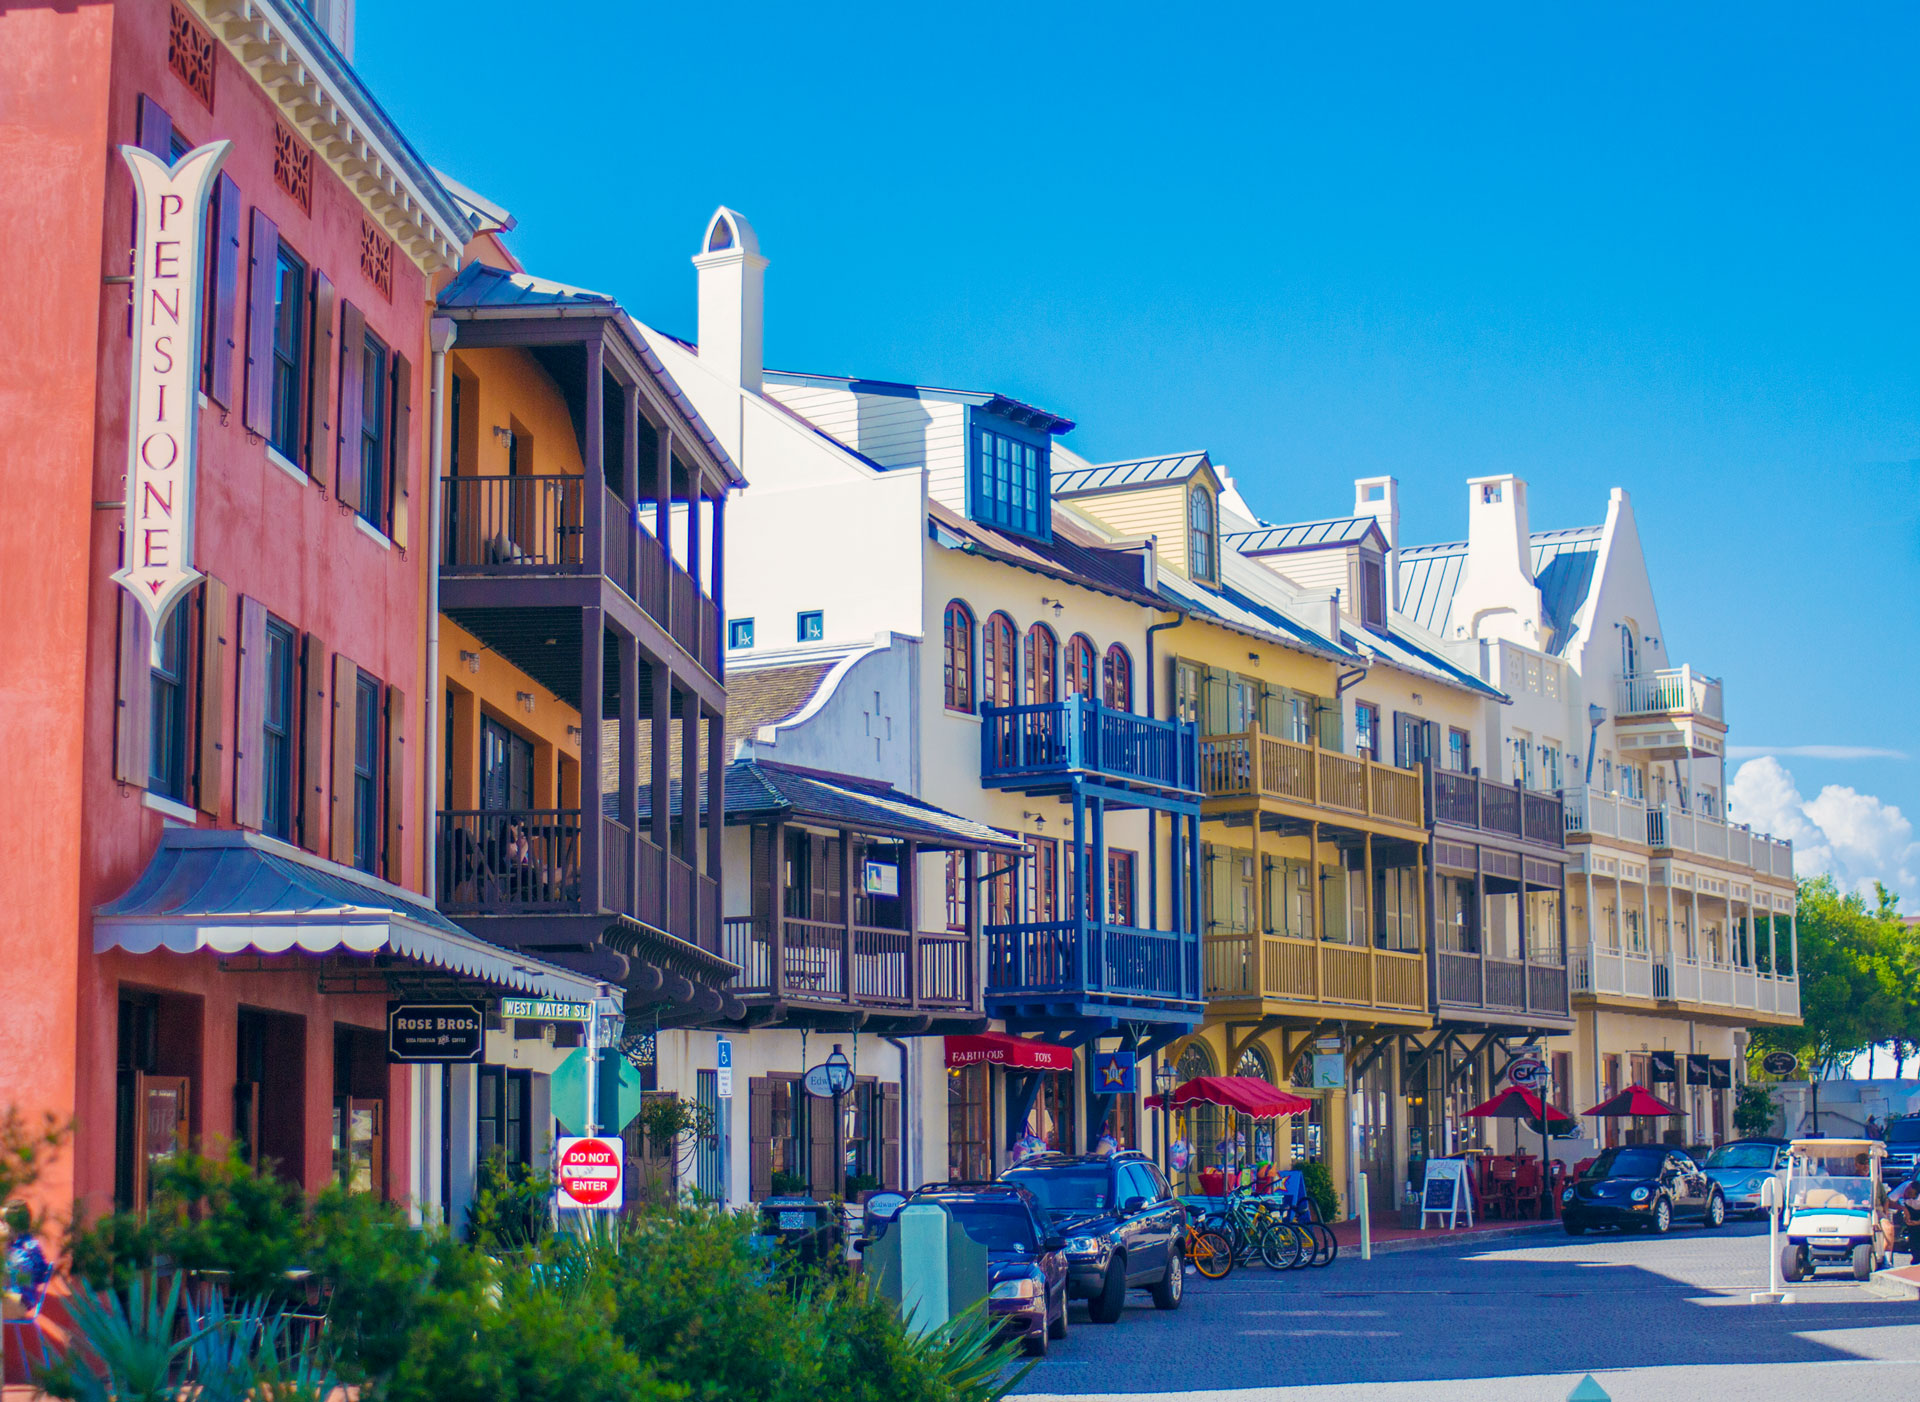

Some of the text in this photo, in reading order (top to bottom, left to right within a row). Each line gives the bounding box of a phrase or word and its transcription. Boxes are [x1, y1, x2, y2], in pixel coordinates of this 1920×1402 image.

[141, 194, 184, 568] PENSIONE
[506, 1000, 587, 1018] WEST WATER ST.
[397, 1018, 479, 1030] ROSE BROS.
[1034, 1052, 1052, 1063] TOYS
[570, 1152, 611, 1163] DO NOT
[572, 1181, 608, 1191] ENTER
